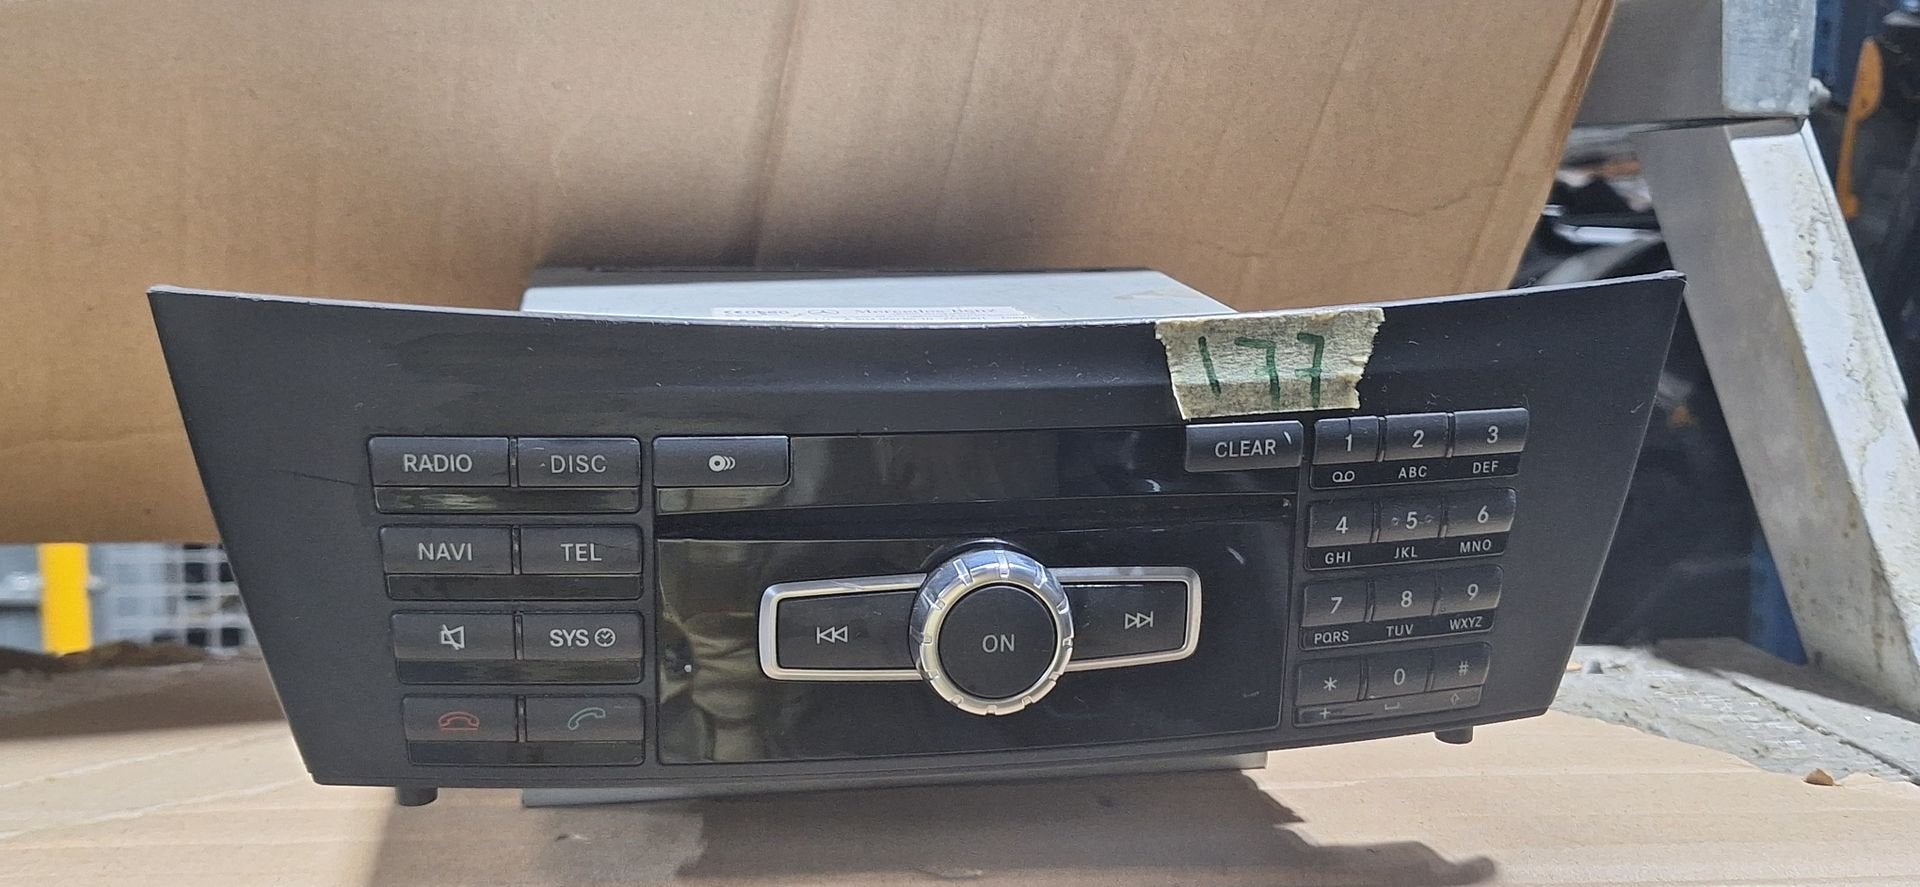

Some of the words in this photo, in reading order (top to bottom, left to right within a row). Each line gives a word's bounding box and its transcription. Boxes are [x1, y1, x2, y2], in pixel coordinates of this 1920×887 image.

[1198, 333, 1325, 408] 177
[1345, 434, 1352, 451] 1
[1413, 430, 1424, 449] 2
[1487, 426, 1499, 444] 3
[1215, 439, 1277, 457] CLEAR
[403, 455, 472, 473] RADIO
[550, 455, 607, 474] DISC
[1398, 465, 1427, 479] ABC
[1472, 461, 1499, 474] DEF
[1406, 512, 1417, 529] 5
[1477, 506, 1489, 523] 6
[1335, 517, 1348, 534] 4
[418, 543, 473, 561] NAVI
[561, 544, 602, 561] TEL
[1393, 546, 1417, 560] JKL
[1460, 540, 1492, 553] MNO
[1325, 551, 1351, 565] GHI
[1401, 590, 1413, 607] 8
[1467, 584, 1479, 601] 9
[1330, 597, 1342, 614] 7
[1386, 624, 1414, 637] TUV
[1449, 617, 1482, 629] WXYZ
[549, 630, 589, 647] SYS
[982, 634, 1015, 653] ON
[1314, 630, 1349, 644] PQRS
